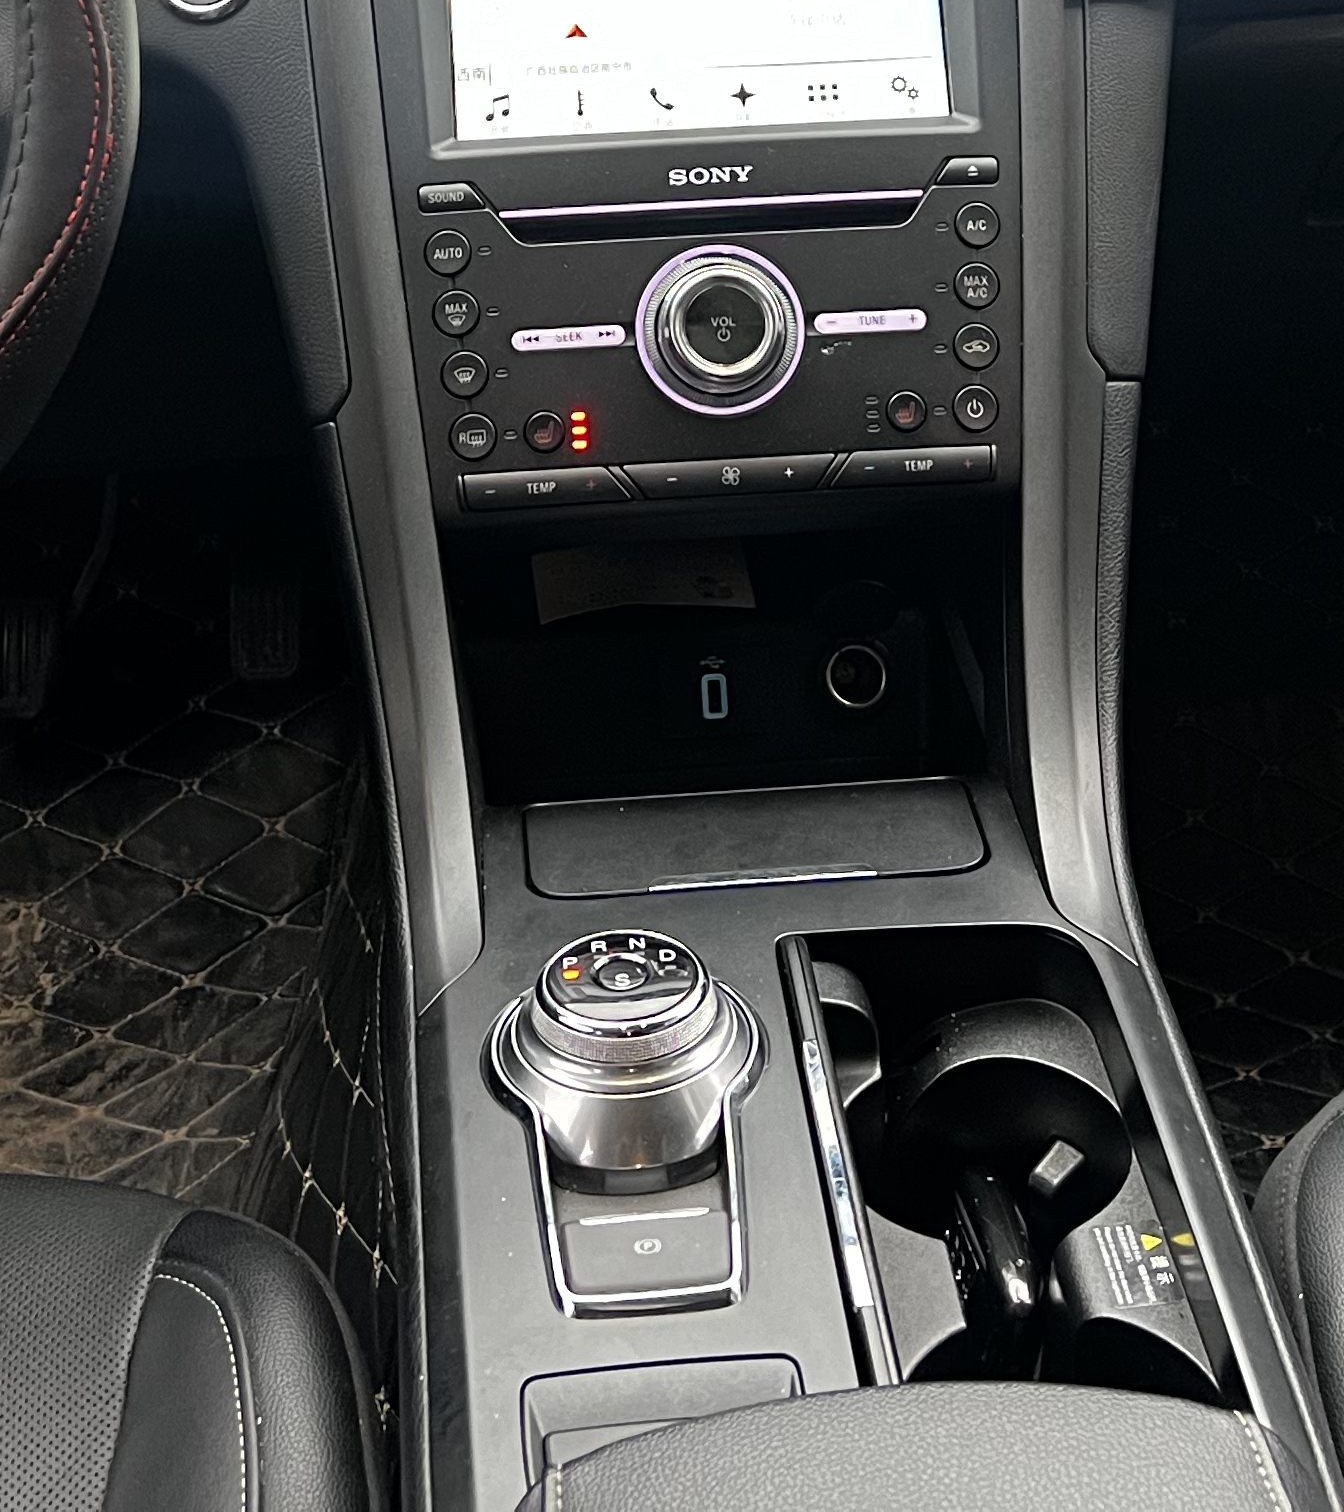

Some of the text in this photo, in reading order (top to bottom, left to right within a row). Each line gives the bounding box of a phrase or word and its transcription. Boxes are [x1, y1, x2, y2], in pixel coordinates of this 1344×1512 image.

[457, 67, 486, 82] 西南
[668, 165, 753, 186] SONY
[427, 191, 464, 204] SOUND
[966, 219, 987, 231] A/C
[433, 247, 463, 260] AUTO
[964, 275, 988, 287] MAX
[967, 287, 987, 298] A/C
[444, 303, 468, 314] MAX
[710, 316, 736, 327] VOL
[859, 315, 886, 326] TUNE
[555, 331, 582, 342] SEEK
[904, 459, 933, 472] TEMP
[526, 481, 556, 494] TEMP
[591, 941, 607, 953] R
[629, 938, 646, 950] N
[659, 949, 676, 962] D
[562, 957, 578, 969] P
[614, 973, 631, 986] S
